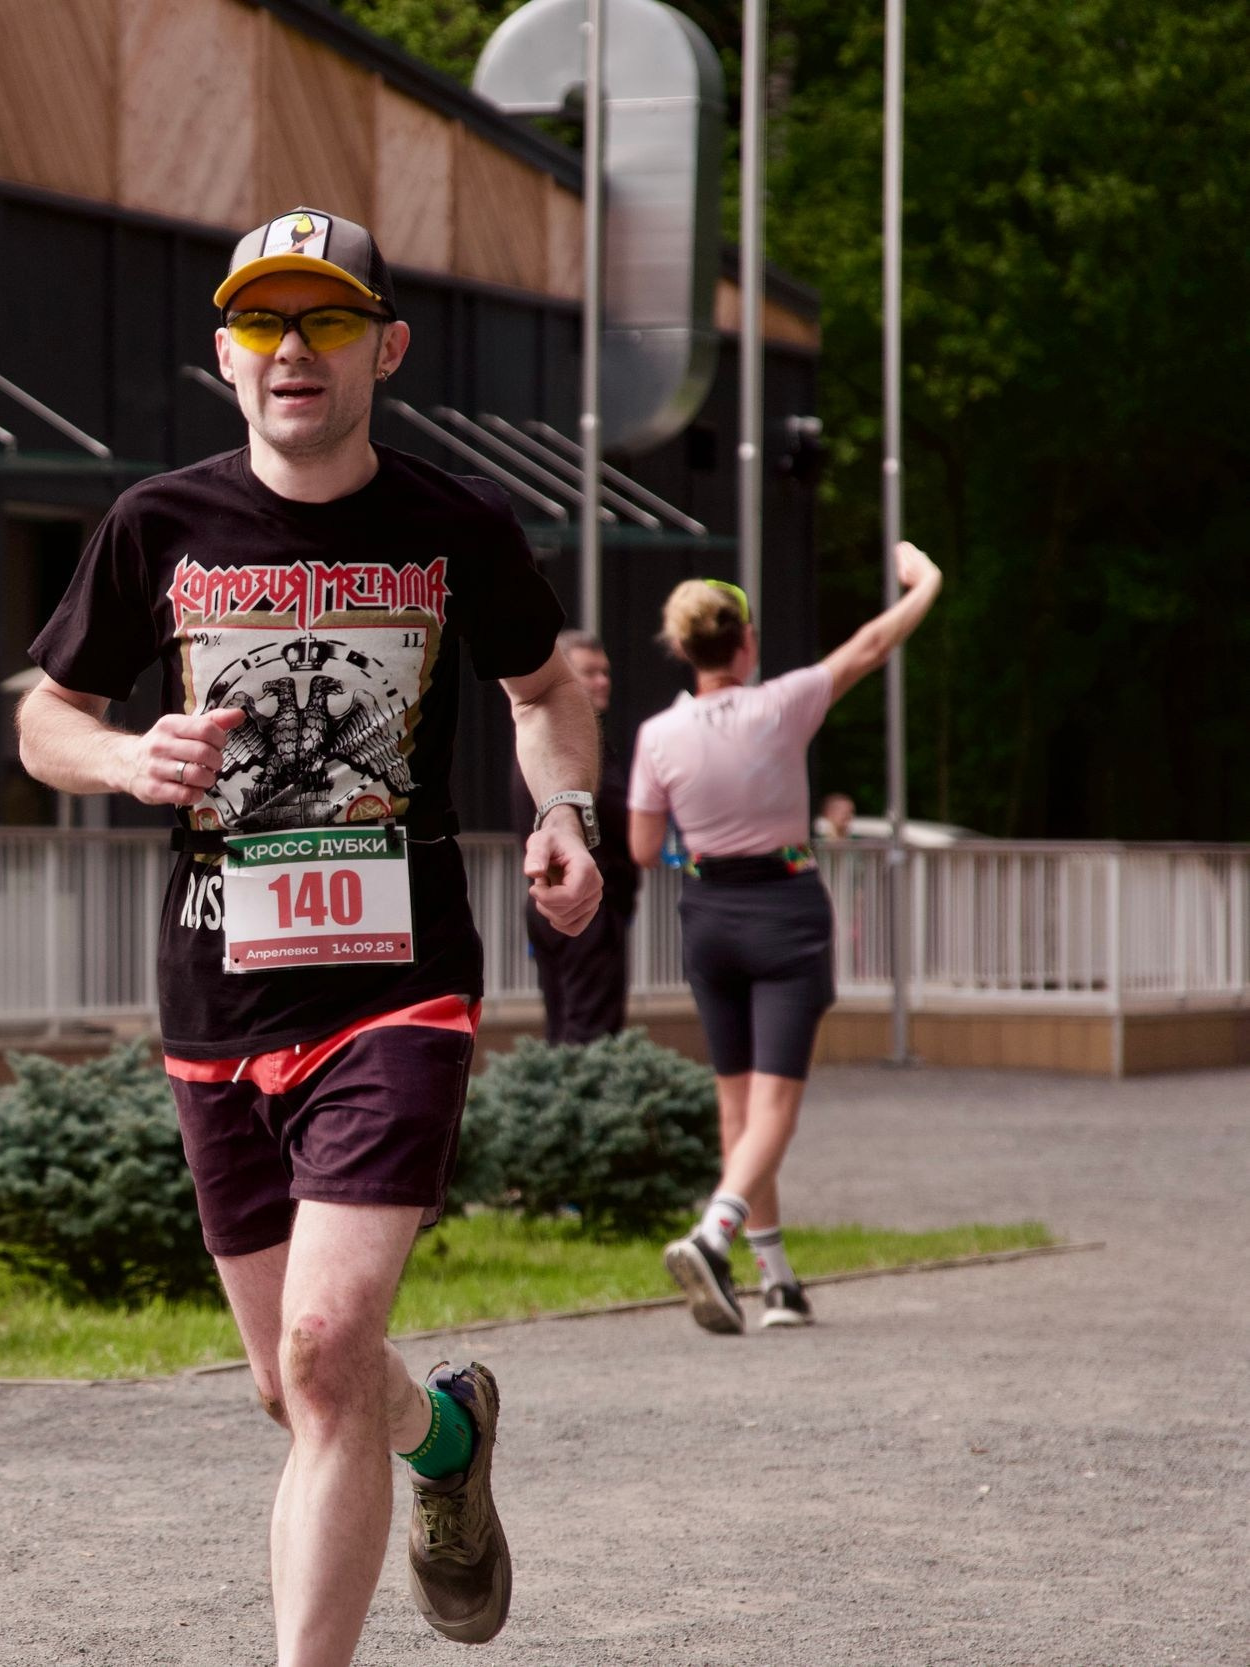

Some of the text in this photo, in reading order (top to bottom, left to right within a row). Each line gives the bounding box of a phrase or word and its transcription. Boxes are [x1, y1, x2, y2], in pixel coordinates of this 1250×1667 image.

[244, 838, 388, 861] КРОСС ДУБКИ
[268, 869, 363, 929] 140
[246, 942, 395, 961] Апрелевка 14.09.25
